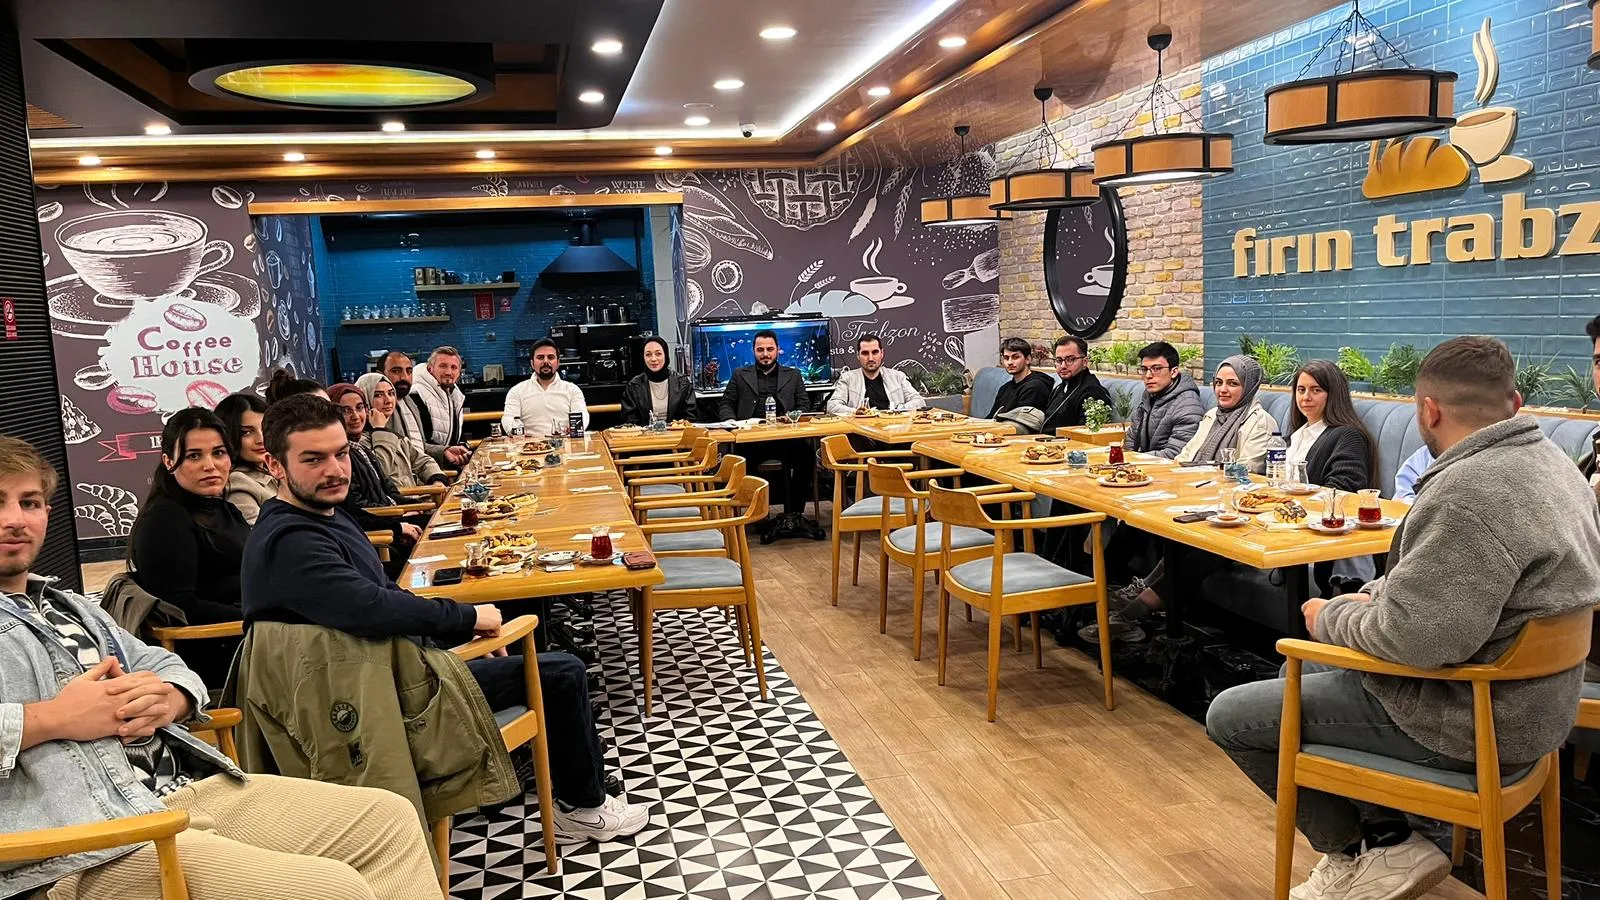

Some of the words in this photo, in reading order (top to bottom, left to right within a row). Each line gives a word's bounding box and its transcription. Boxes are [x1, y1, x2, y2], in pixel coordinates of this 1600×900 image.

[1232, 227, 1353, 278] fırın
[137, 326, 232, 357] Coffee
[131, 354, 243, 378] House
